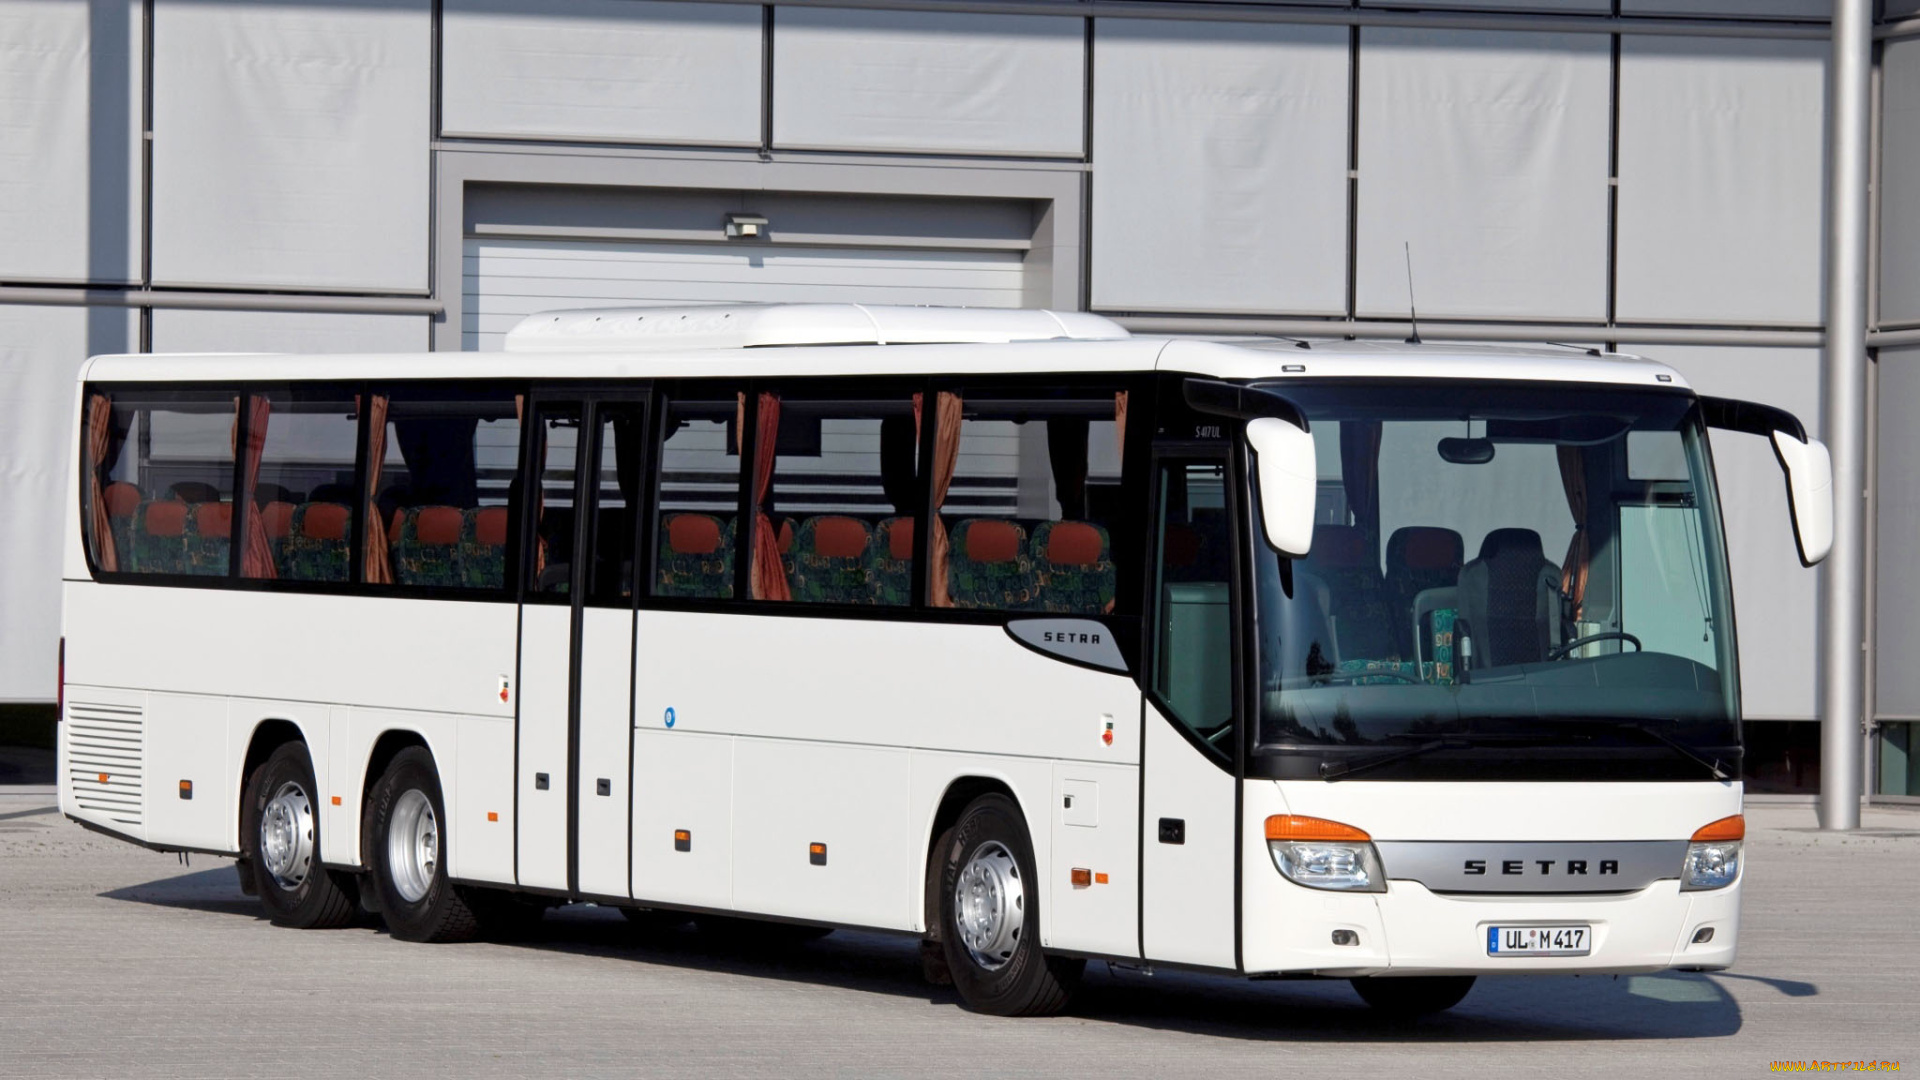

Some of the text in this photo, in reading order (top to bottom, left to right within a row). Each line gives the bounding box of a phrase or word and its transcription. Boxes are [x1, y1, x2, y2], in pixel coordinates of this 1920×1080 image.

[1043, 632, 1101, 645] SETRA
[1464, 860, 1618, 875] SETRA
[1506, 930, 1528, 949] UL
